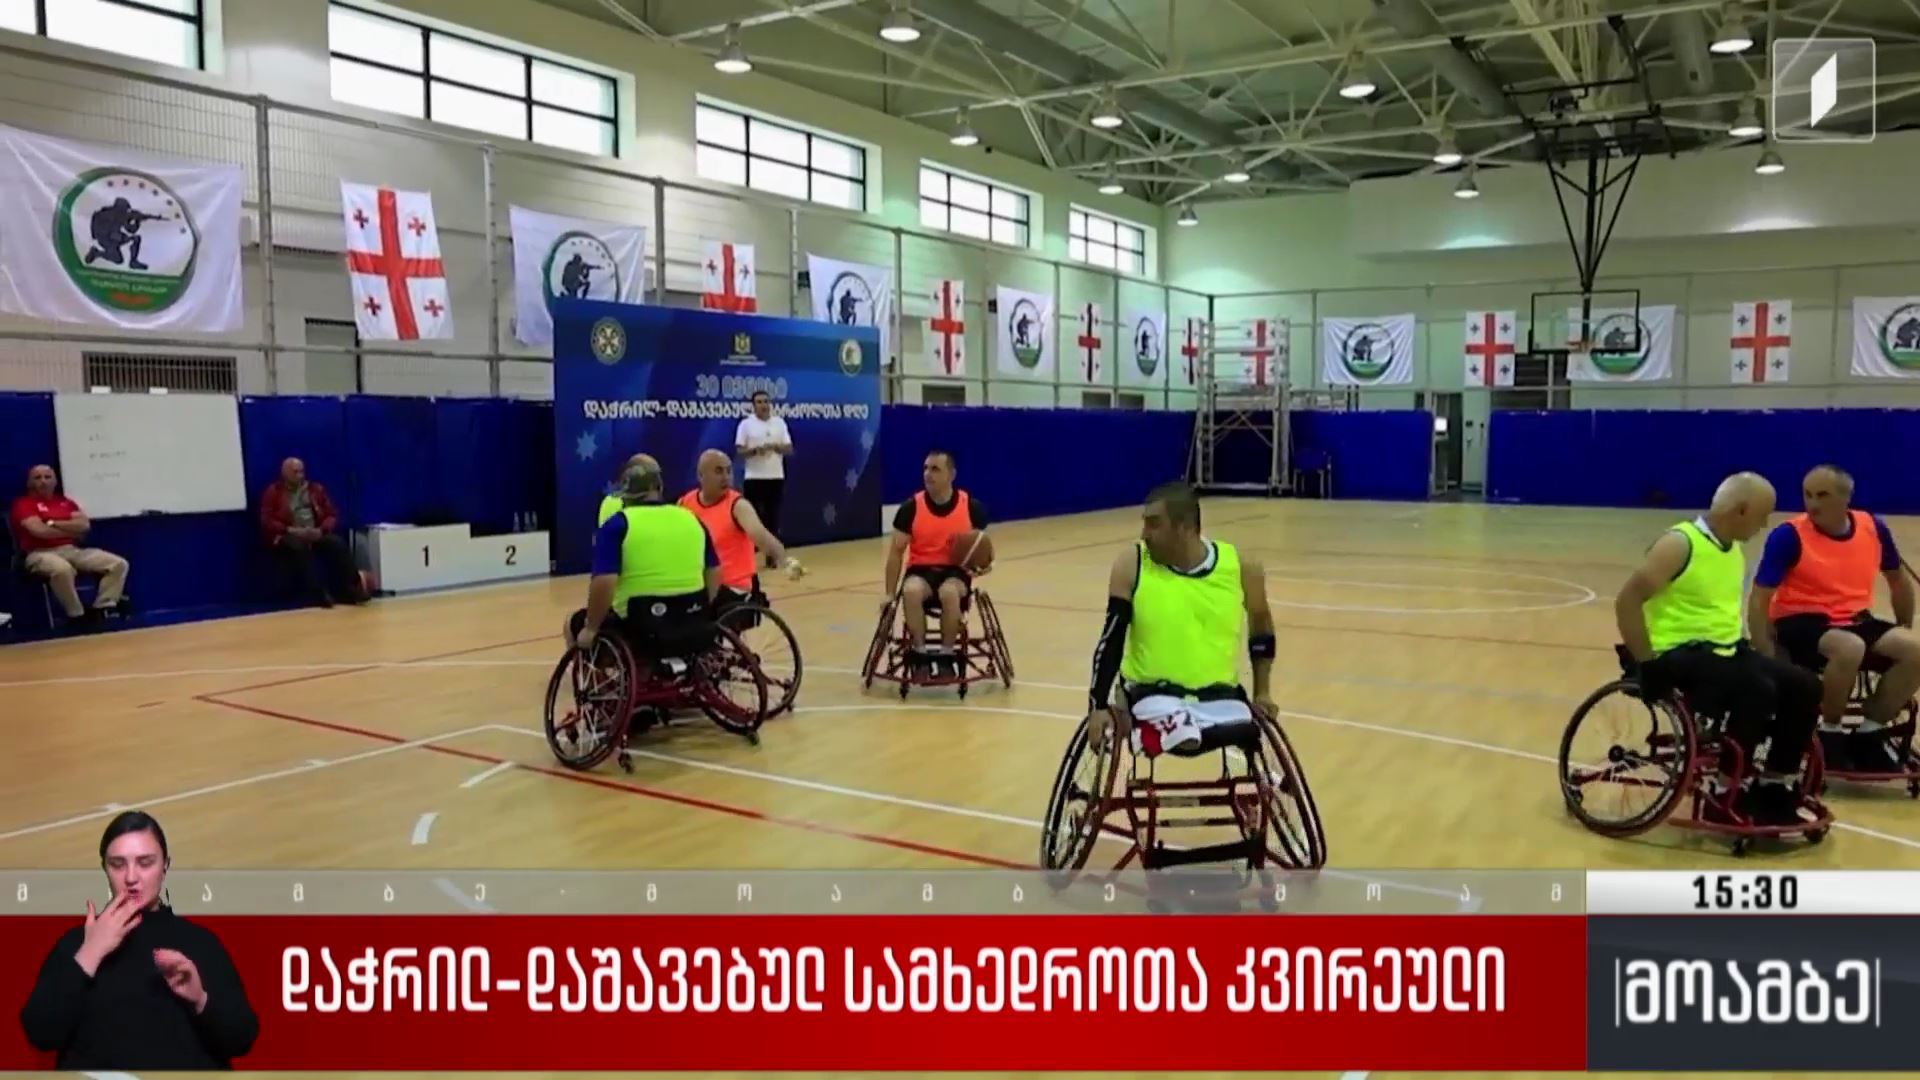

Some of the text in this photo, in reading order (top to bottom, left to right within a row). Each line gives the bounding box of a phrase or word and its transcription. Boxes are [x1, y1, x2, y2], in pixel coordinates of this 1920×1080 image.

[769, 402, 842, 420] ბრძოლთა
[422, 545, 429, 567] 1
[505, 545, 517, 566] 2
